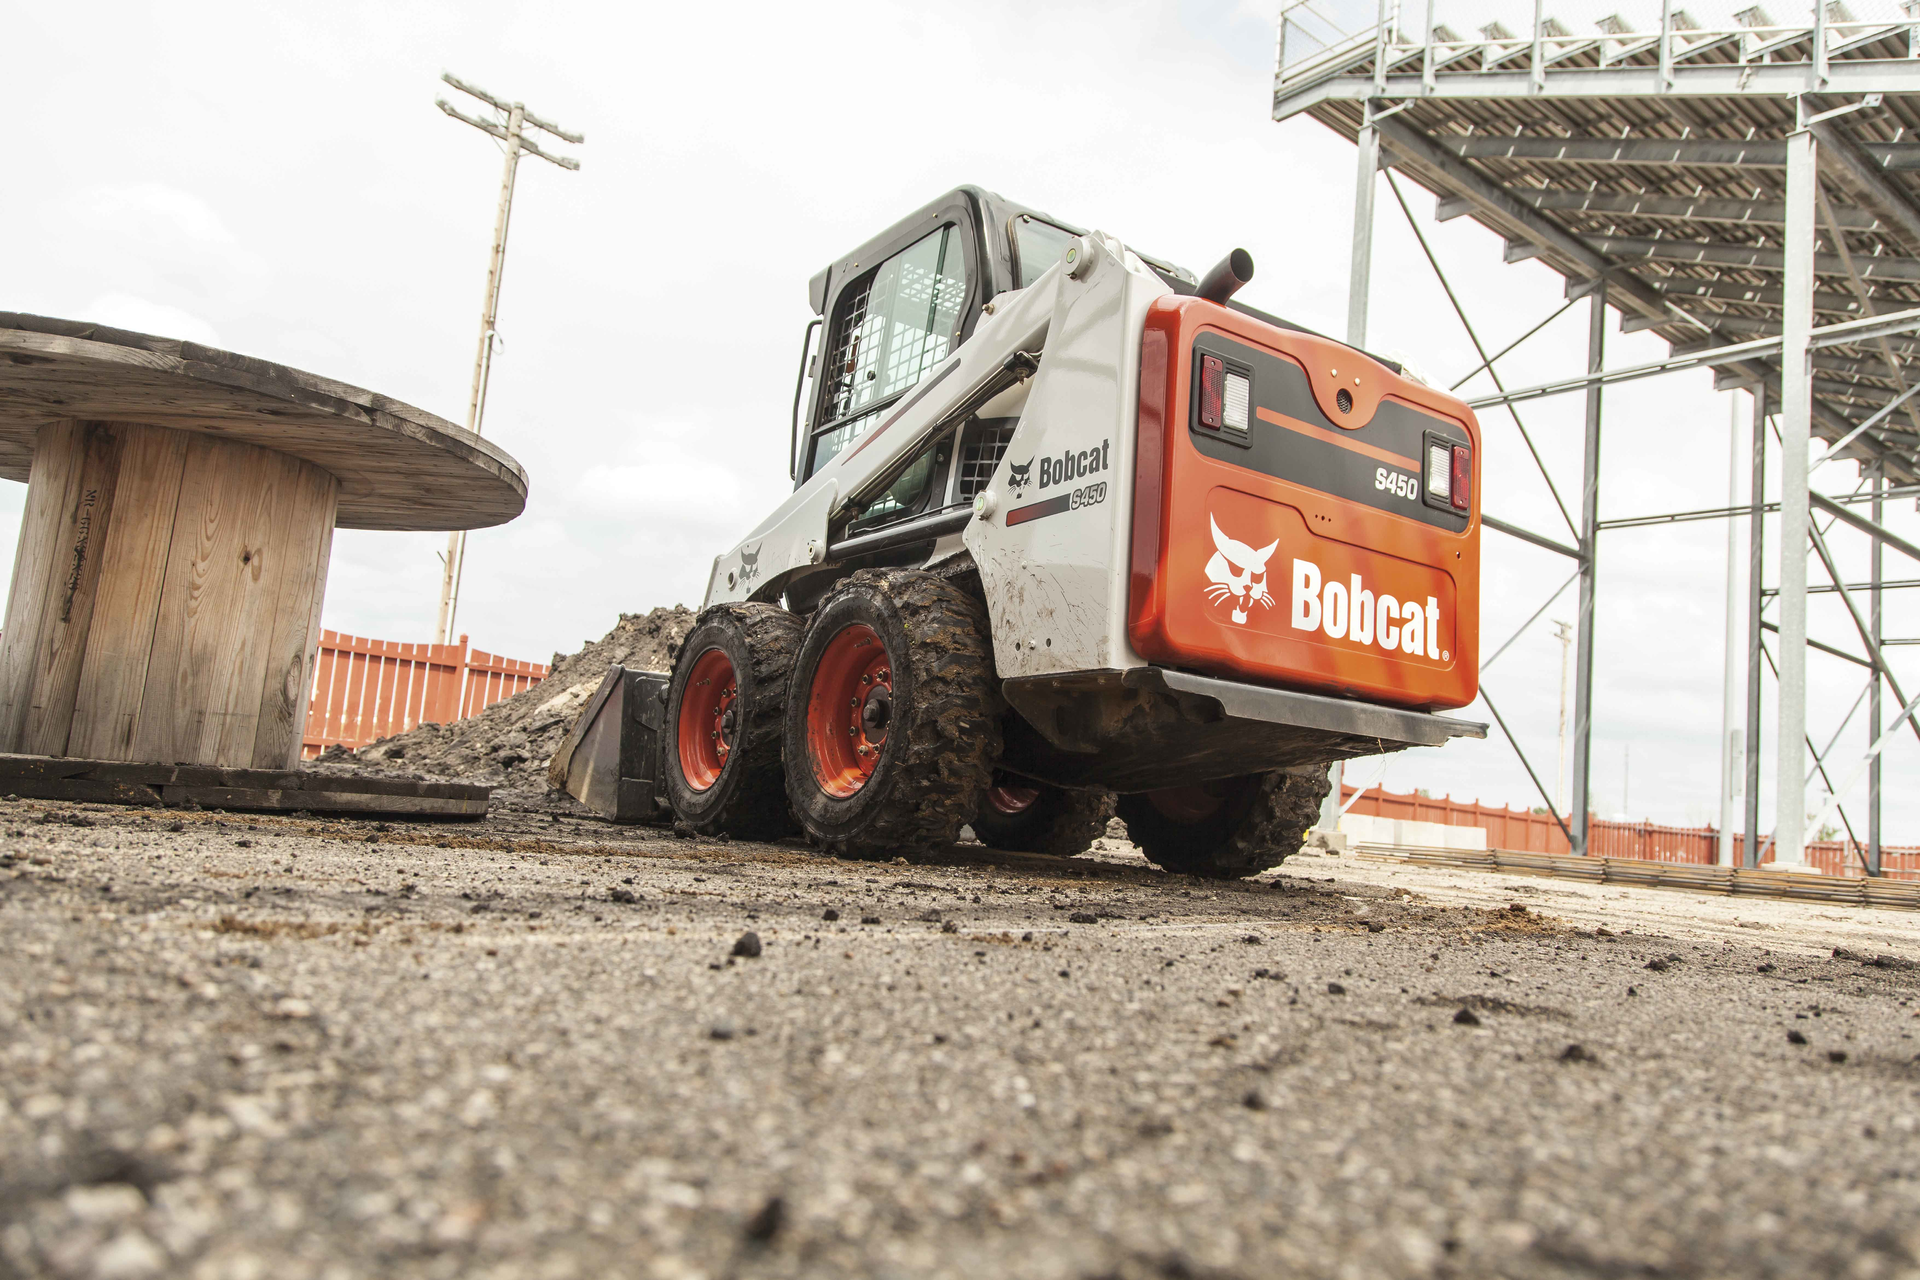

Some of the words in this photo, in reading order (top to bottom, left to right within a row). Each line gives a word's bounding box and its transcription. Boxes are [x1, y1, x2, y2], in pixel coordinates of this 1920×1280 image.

[1039, 438, 1109, 490] Bobcat
[1070, 481, 1108, 511] S450
[1375, 467, 1418, 500] S450
